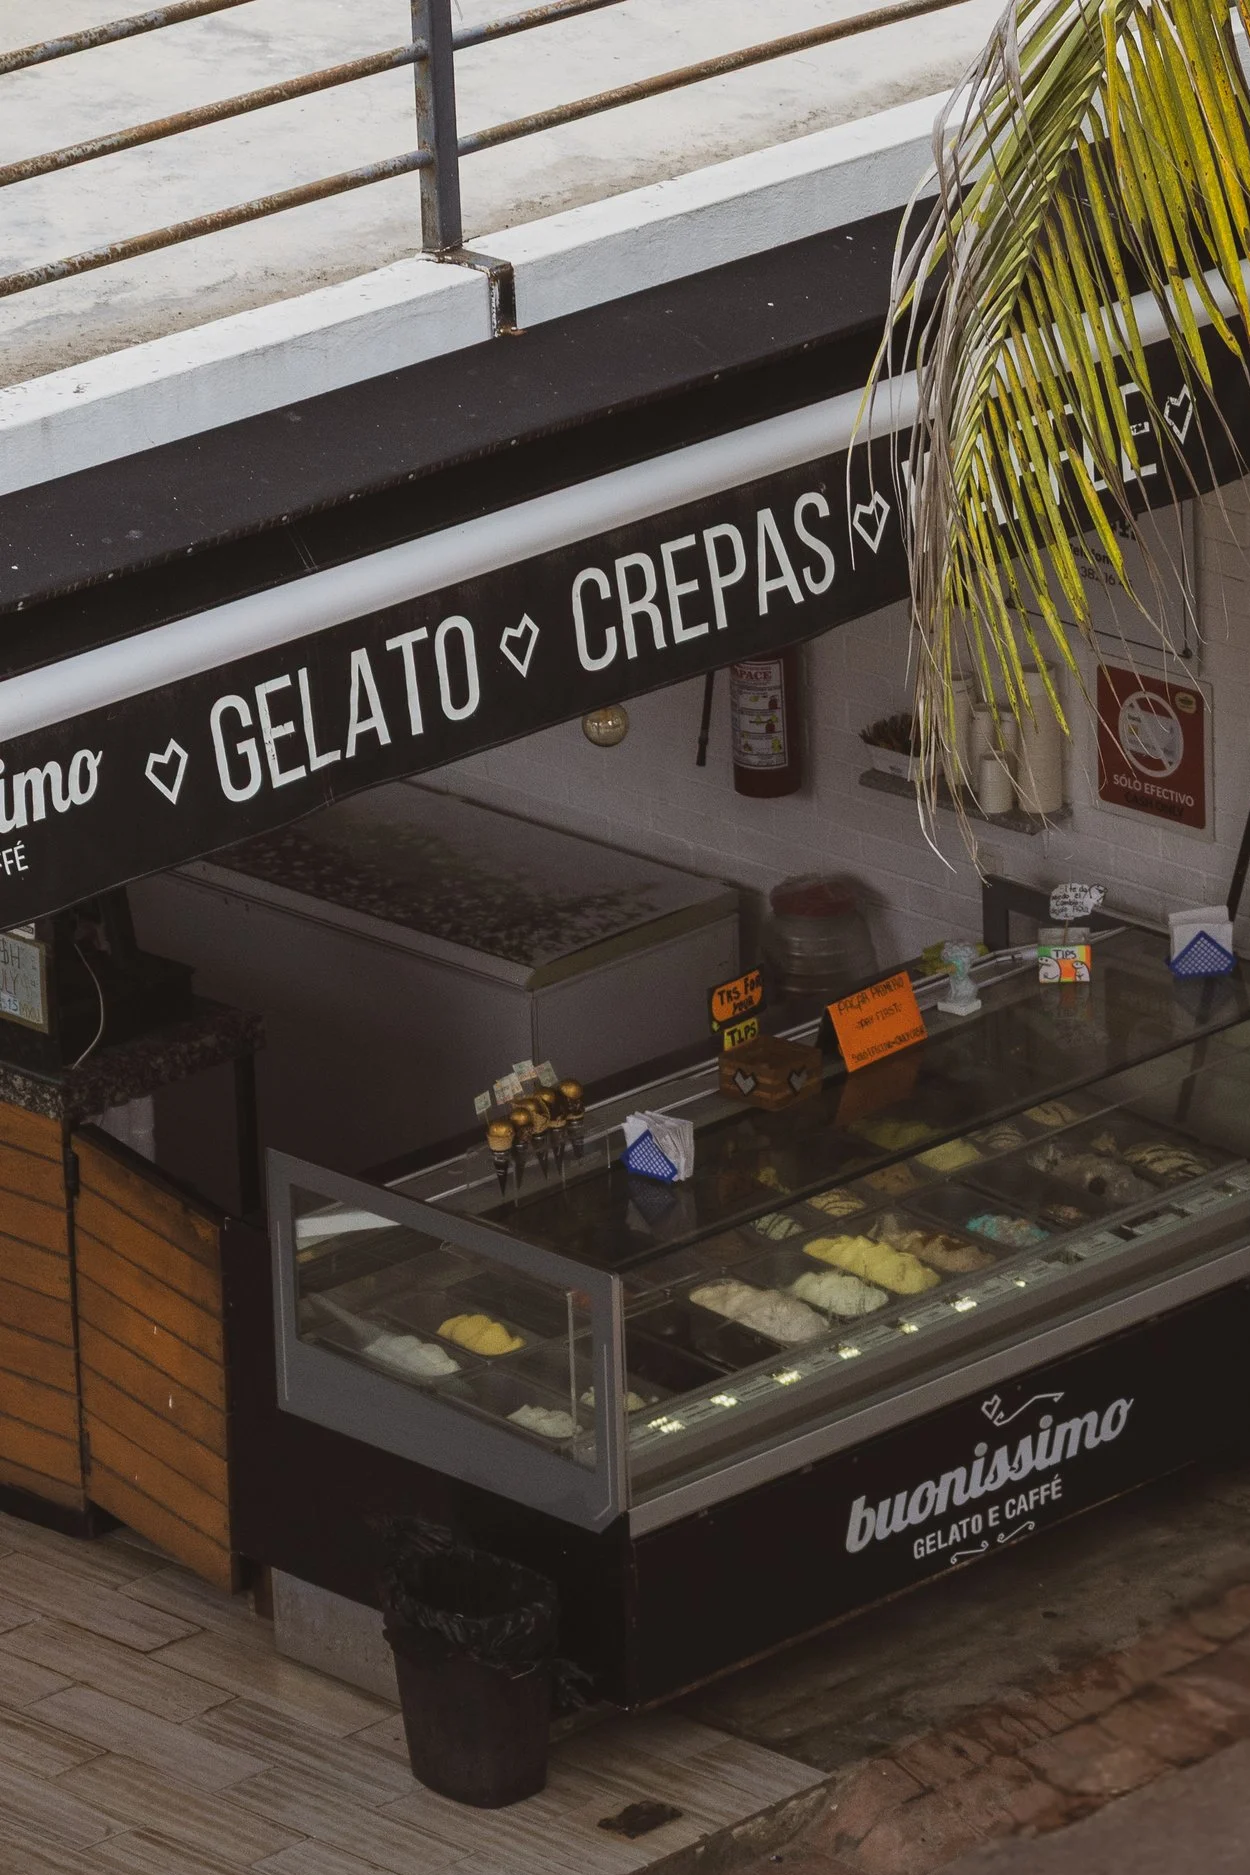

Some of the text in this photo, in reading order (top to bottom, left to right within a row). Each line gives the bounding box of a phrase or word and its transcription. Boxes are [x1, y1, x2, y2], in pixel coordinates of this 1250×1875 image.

[209, 615, 481, 803] GELATO
[571, 492, 836, 672] CREPAS
[1112, 772, 1195, 808] SÓLO EFECTIVO
[1124, 791, 1153, 811] CASH
[1052, 949, 1077, 960] TIPS
[727, 1022, 758, 1047] TIPS
[845, 1398, 1135, 1553] buonissimo
[913, 1473, 1063, 1560] GELATO E CAFFÉ
